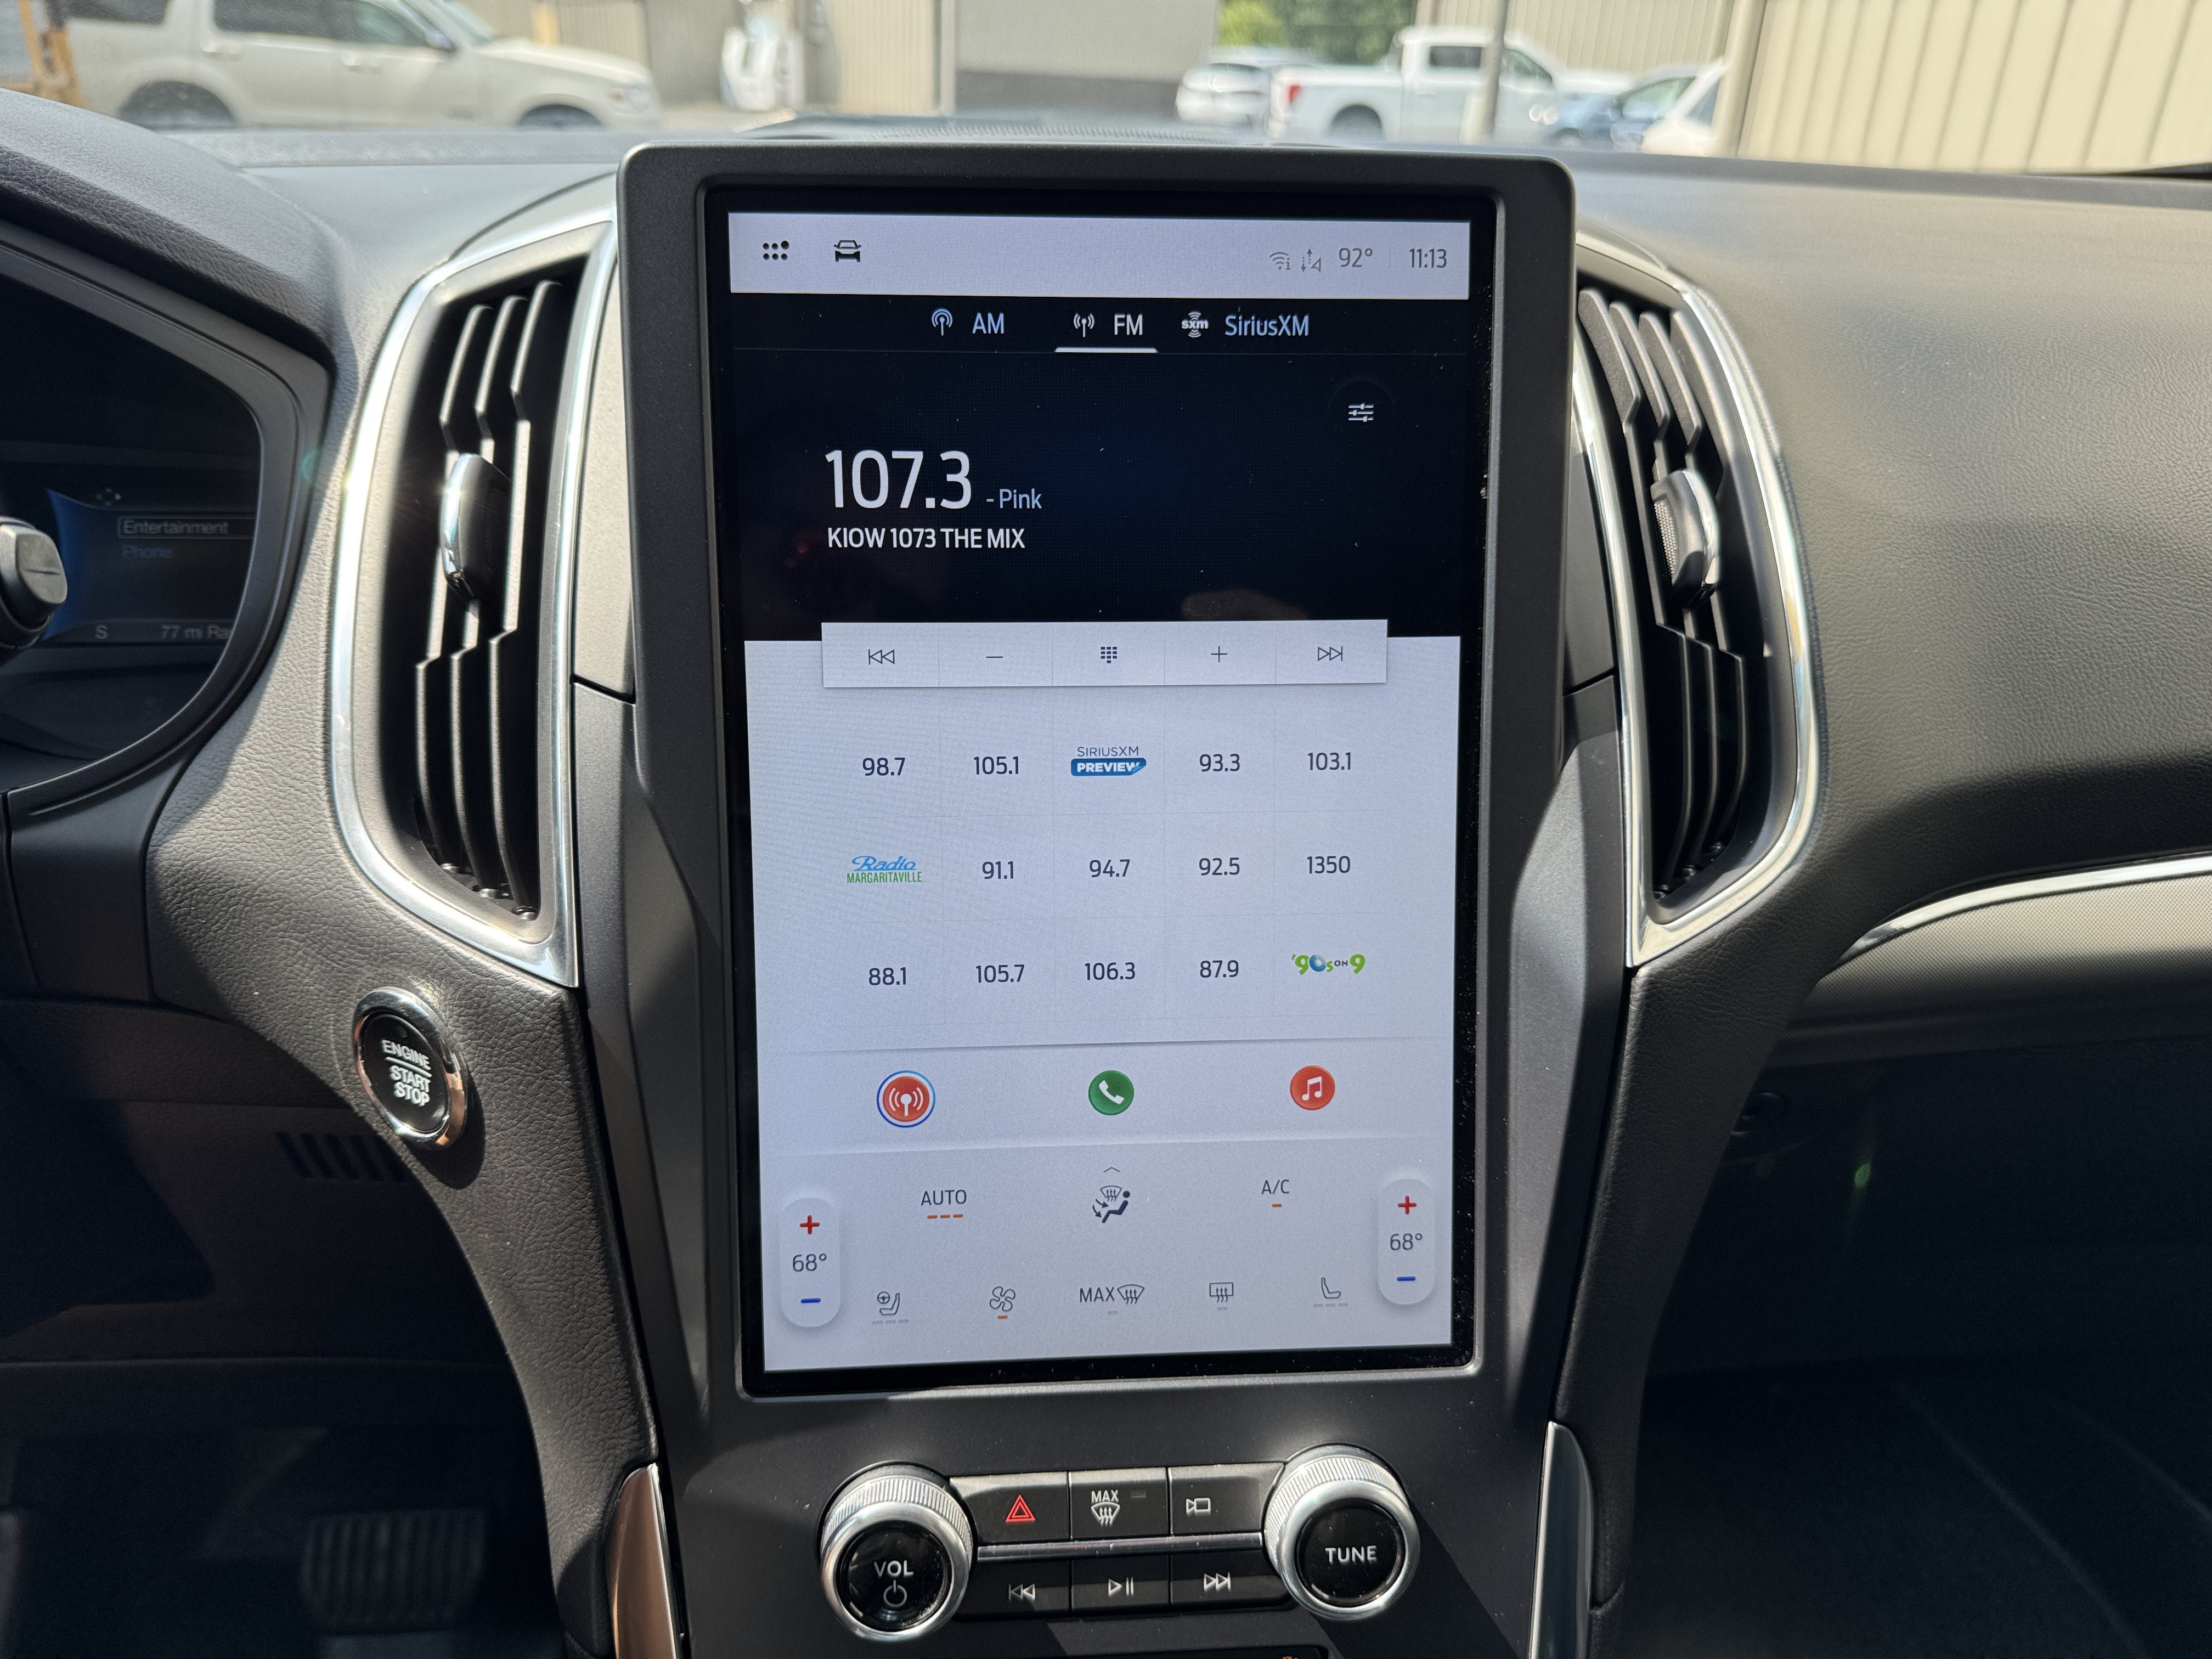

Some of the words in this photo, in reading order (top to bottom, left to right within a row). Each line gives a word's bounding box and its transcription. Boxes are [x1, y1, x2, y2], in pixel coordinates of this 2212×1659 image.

[1339, 248, 1373, 267] 92°
[1409, 249, 1447, 268] 11:13
[973, 313, 1004, 334] AM
[1114, 314, 1142, 335] FM
[1225, 314, 1309, 336] SiriusXM
[826, 450, 971, 509] 107.3
[1000, 488, 1042, 509] Pink
[123, 519, 228, 535] Entertainment
[828, 528, 885, 548] KIOW
[890, 528, 936, 548] 1073
[940, 528, 982, 548] THE
[988, 528, 1025, 548] MIX
[95, 624, 109, 640] S
[207, 624, 233, 640] Ra
[1077, 747, 1139, 757] SIRIUSXM
[1308, 752, 1351, 770] 103.1
[863, 758, 905, 776] 98.7
[974, 757, 1018, 775] 105.1
[1077, 761, 1140, 773] PREVIEW
[1200, 754, 1240, 772] 93.3
[852, 856, 916, 871] Radio
[983, 861, 1013, 879] 91.1
[1090, 859, 1130, 877] 94.7
[1199, 857, 1240, 876] 92.5
[1307, 856, 1350, 873] 1350
[847, 871, 922, 883] MARGARITAVILLE
[1085, 962, 1135, 980] 106.3
[1200, 960, 1239, 978] 87.9
[1350, 954, 1365, 974] 9
[869, 967, 906, 985] 88.1
[976, 964, 1024, 983] 105.7
[381, 1039, 431, 1070] ENGINE
[389, 1065, 431, 1092] START
[393, 1081, 430, 1107] STOP
[1261, 1180, 1289, 1194] A/C
[921, 1189, 967, 1206] AUTO
[1390, 1233, 1423, 1251] 68°
[793, 1254, 827, 1272] 68°
[1080, 1286, 1114, 1302] MAX
[1091, 1489, 1119, 1503] MAX
[1325, 1545, 1376, 1564] TUNE
[874, 1560, 913, 1577] VOL
